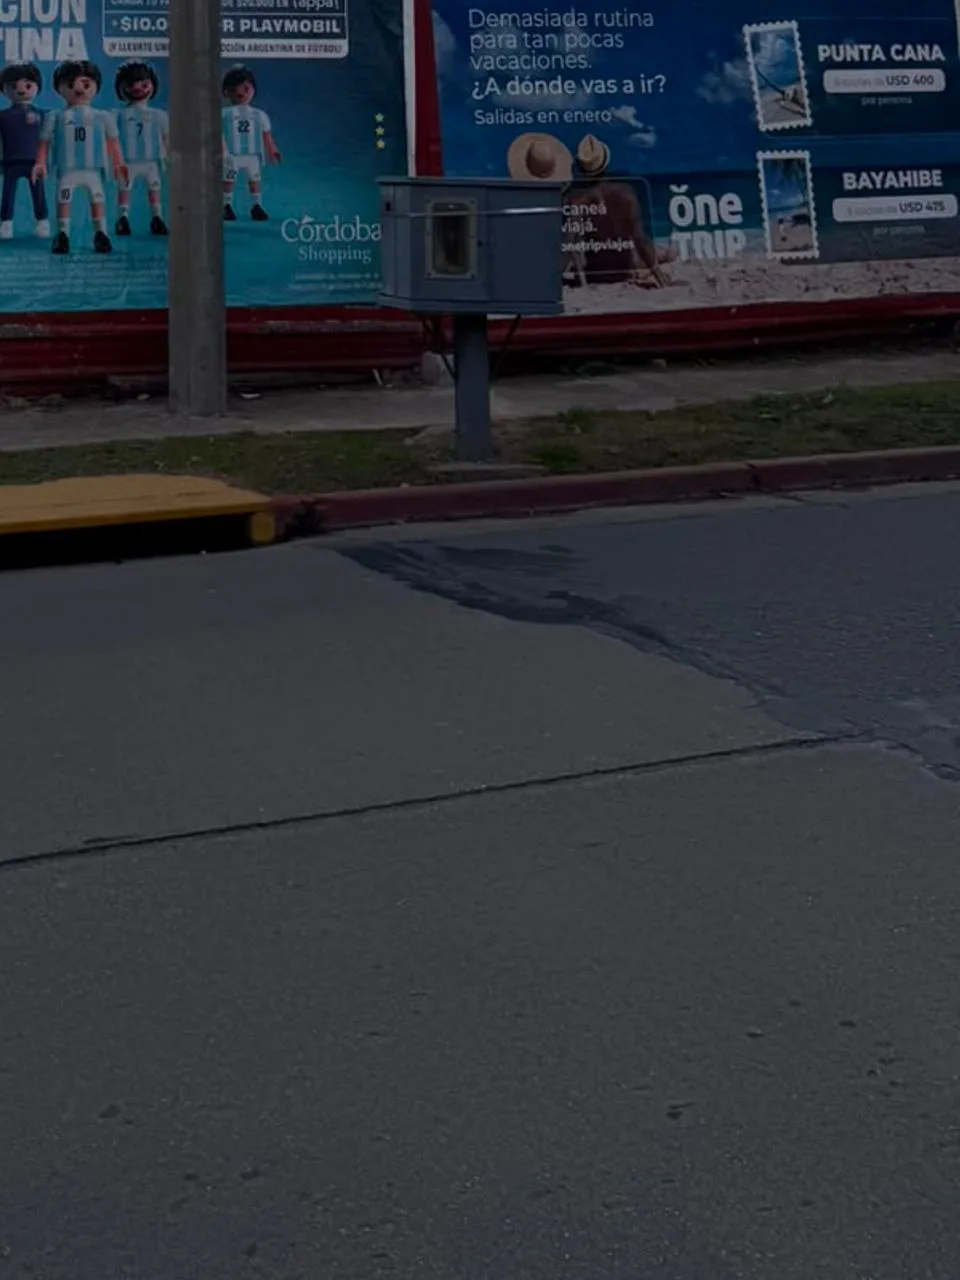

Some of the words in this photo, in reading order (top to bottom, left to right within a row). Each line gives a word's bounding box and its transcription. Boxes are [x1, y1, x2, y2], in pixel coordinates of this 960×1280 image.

[240, 18, 341, 33] PLAYMOBIL
[468, 7, 588, 28] Demasiada
[594, 8, 655, 28] rutina
[247, 42, 293, 53] ARGENTINA
[470, 32, 518, 53] para
[523, 31, 559, 49] tan
[565, 32, 625, 52] pocas
[470, 50, 593, 70] vacaciones.
[817, 43, 887, 62] PUNTA
[890, 43, 946, 61] CANA
[471, 77, 502, 100] ¿A
[506, 74, 577, 96] dónde
[581, 78, 619, 95] vas
[622, 79, 636, 95] a
[639, 73, 667, 94] ir?
[886, 74, 911, 87] USD
[912, 74, 936, 86] 400
[473, 108, 534, 125] Salidas
[537, 111, 560, 124] en
[563, 110, 612, 124] enero
[74, 127, 87, 142] 10
[237, 120, 251, 133] 22
[842, 169, 944, 191] BAYAHIBE
[563, 200, 607, 216] caneá
[898, 200, 924, 214] USD
[281, 213, 383, 243] Córdoba
[670, 228, 747, 261] TRIP
[298, 244, 372, 265] Shopping
